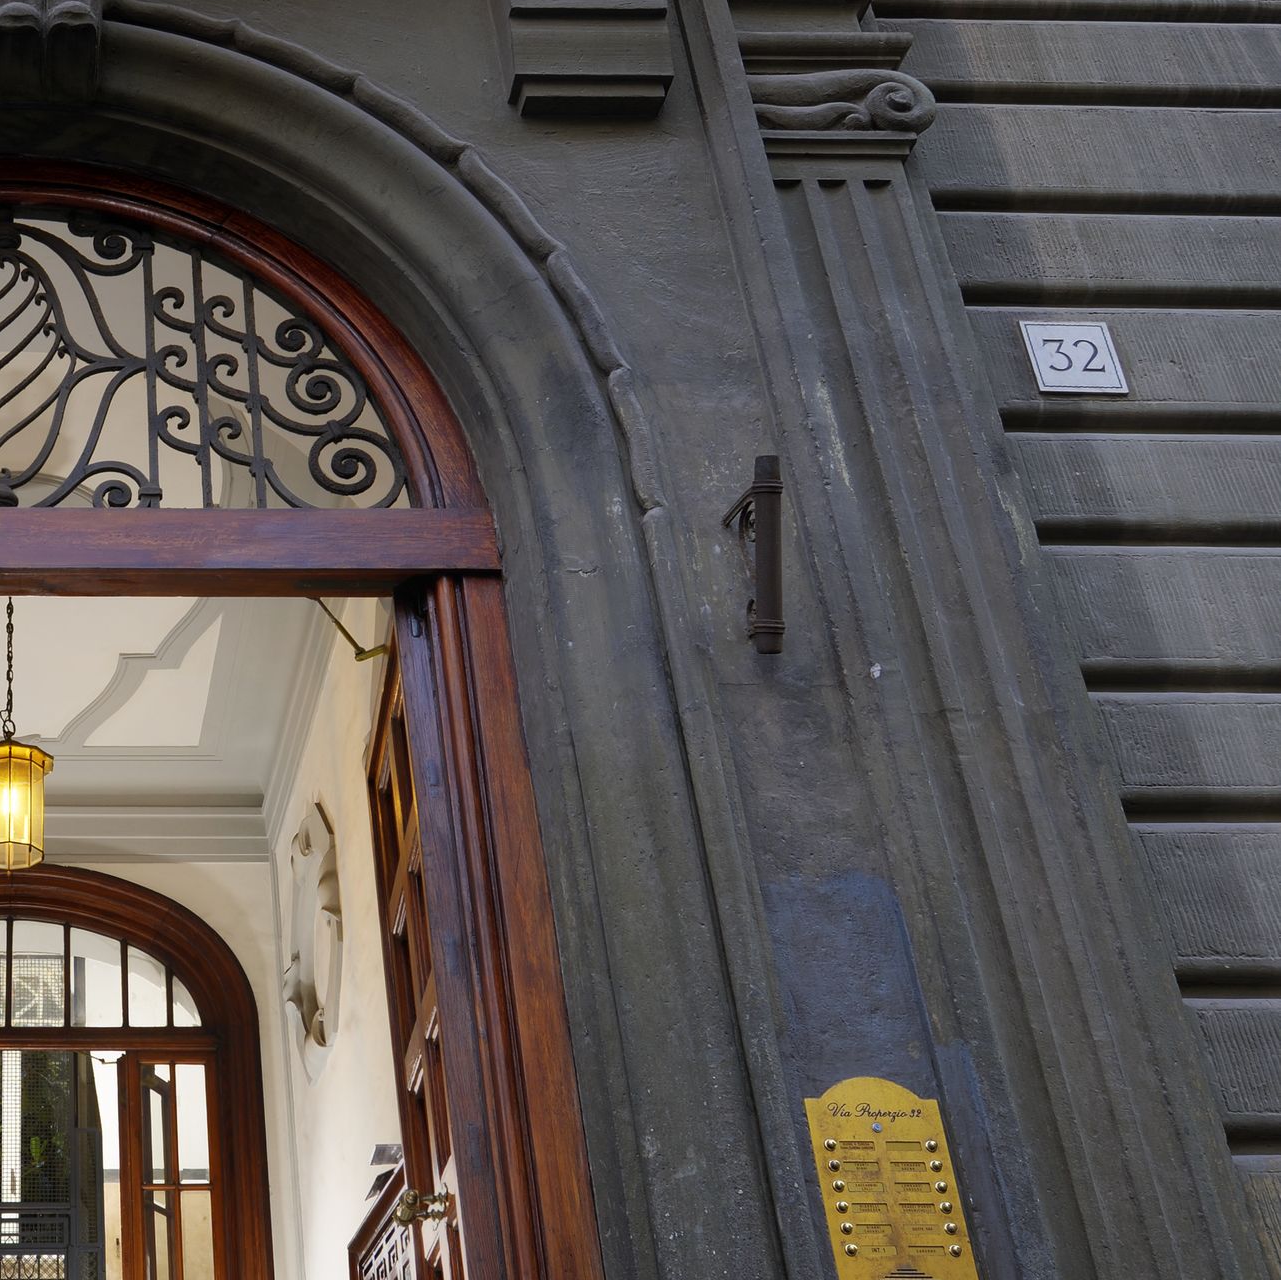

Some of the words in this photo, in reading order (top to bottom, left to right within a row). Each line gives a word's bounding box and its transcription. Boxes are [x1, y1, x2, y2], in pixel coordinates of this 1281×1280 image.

[1042, 339, 1105, 373] 32
[827, 1102, 852, 1118] Via
[855, 1102, 908, 1122] Properzio
[909, 1109, 922, 1118] 32
